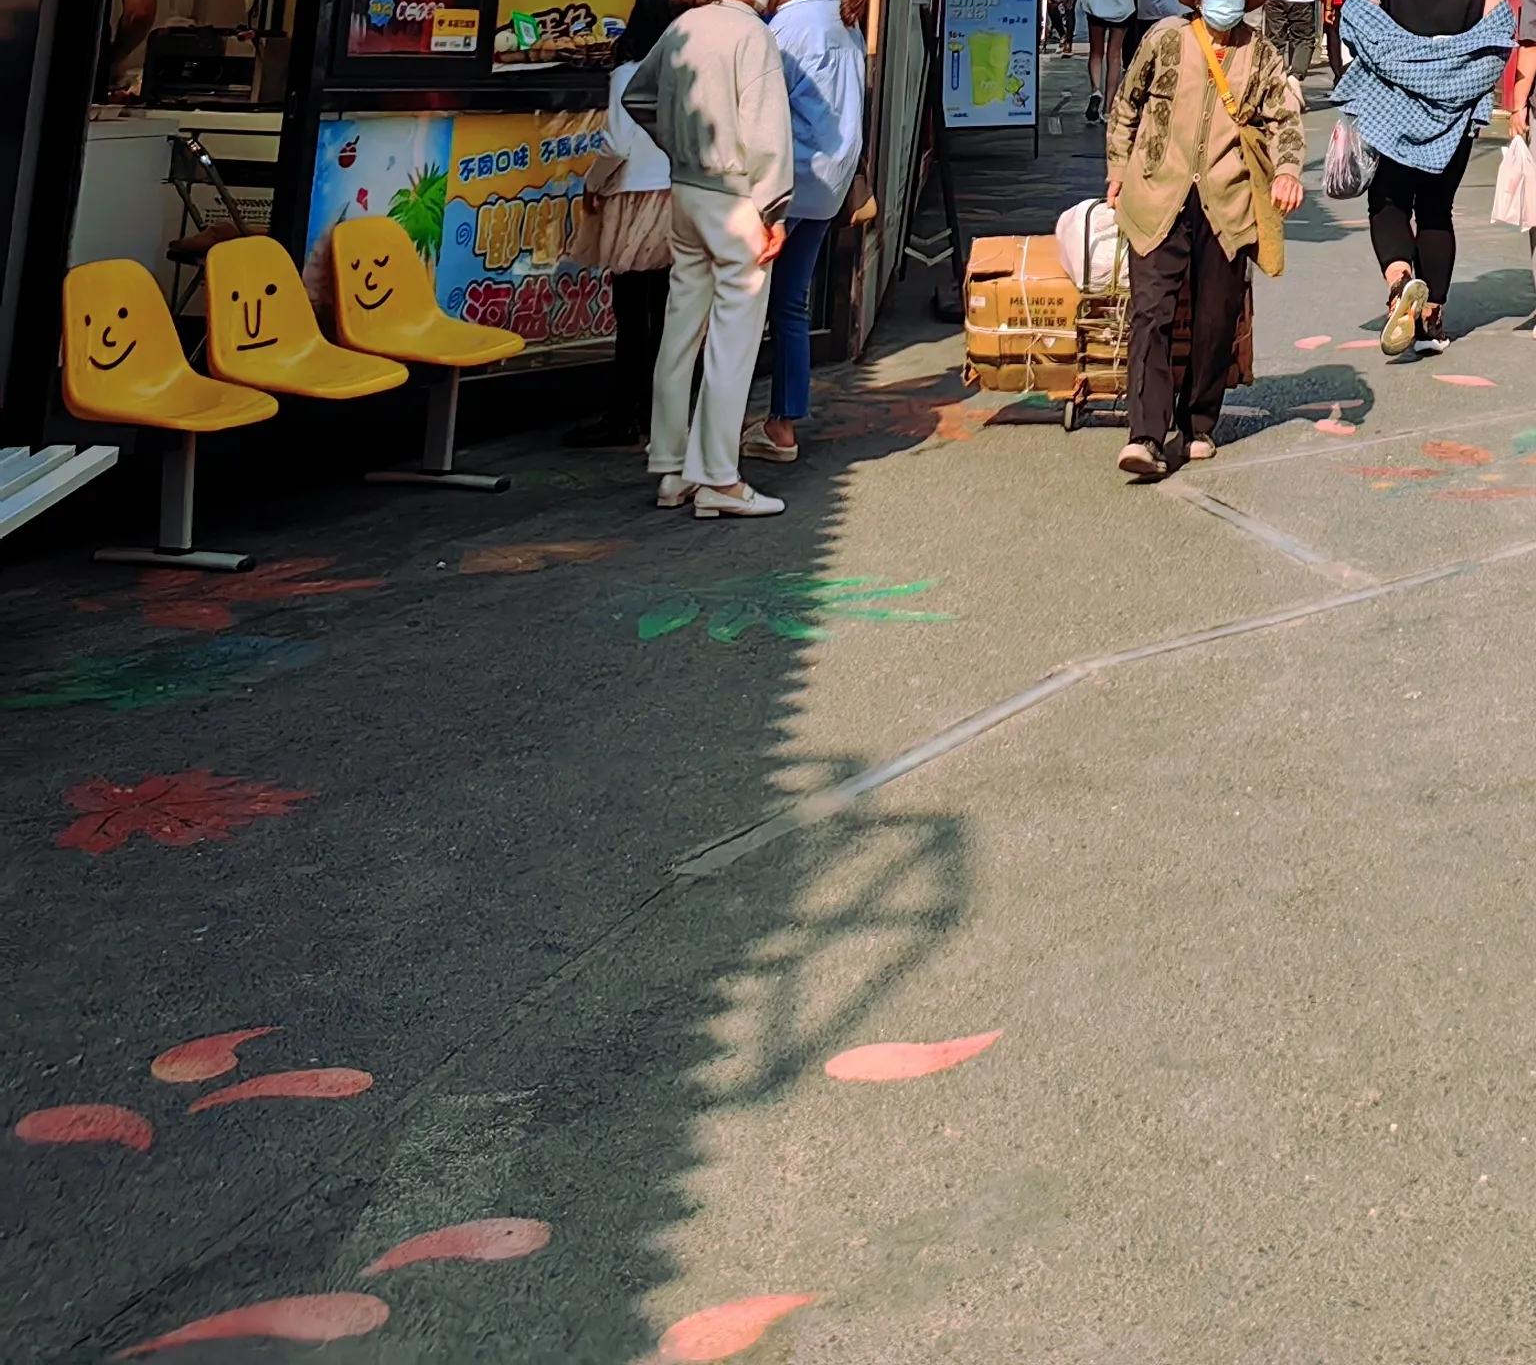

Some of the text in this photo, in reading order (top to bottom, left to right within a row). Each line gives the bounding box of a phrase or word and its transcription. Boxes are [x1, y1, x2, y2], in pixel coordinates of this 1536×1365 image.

[459, 144, 530, 183] 不同口味
[463, 269, 616, 342] 海盐冰
